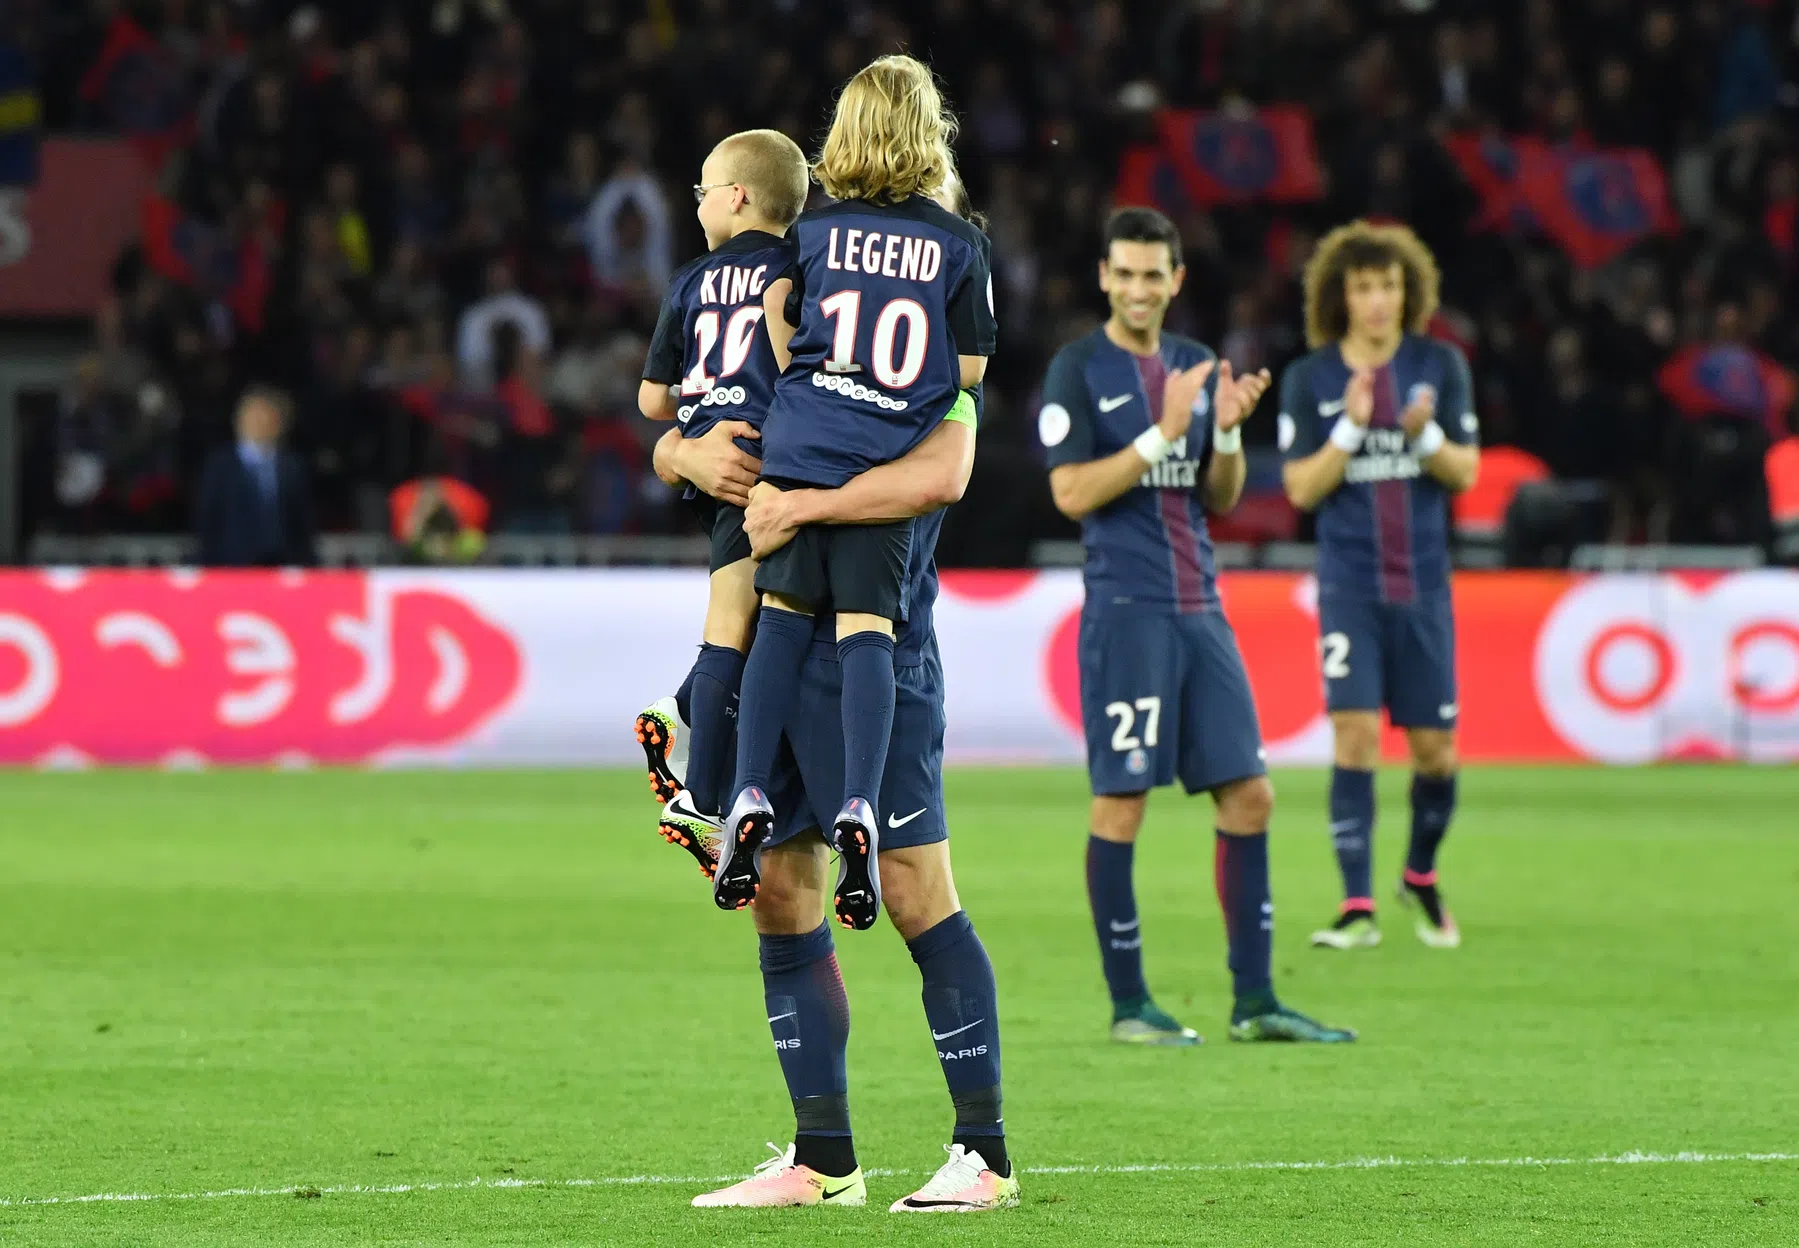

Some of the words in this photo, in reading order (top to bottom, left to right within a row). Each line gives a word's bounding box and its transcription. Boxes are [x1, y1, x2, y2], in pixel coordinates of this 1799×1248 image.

[827, 227, 942, 282] LEGEND
[700, 264, 768, 306] KING
[681, 305, 765, 397] 10
[819, 289, 930, 390] 10
[812, 372, 908, 411] ooredoo
[1105, 696, 1161, 752] 27
[938, 1044, 988, 1060] PARIS
